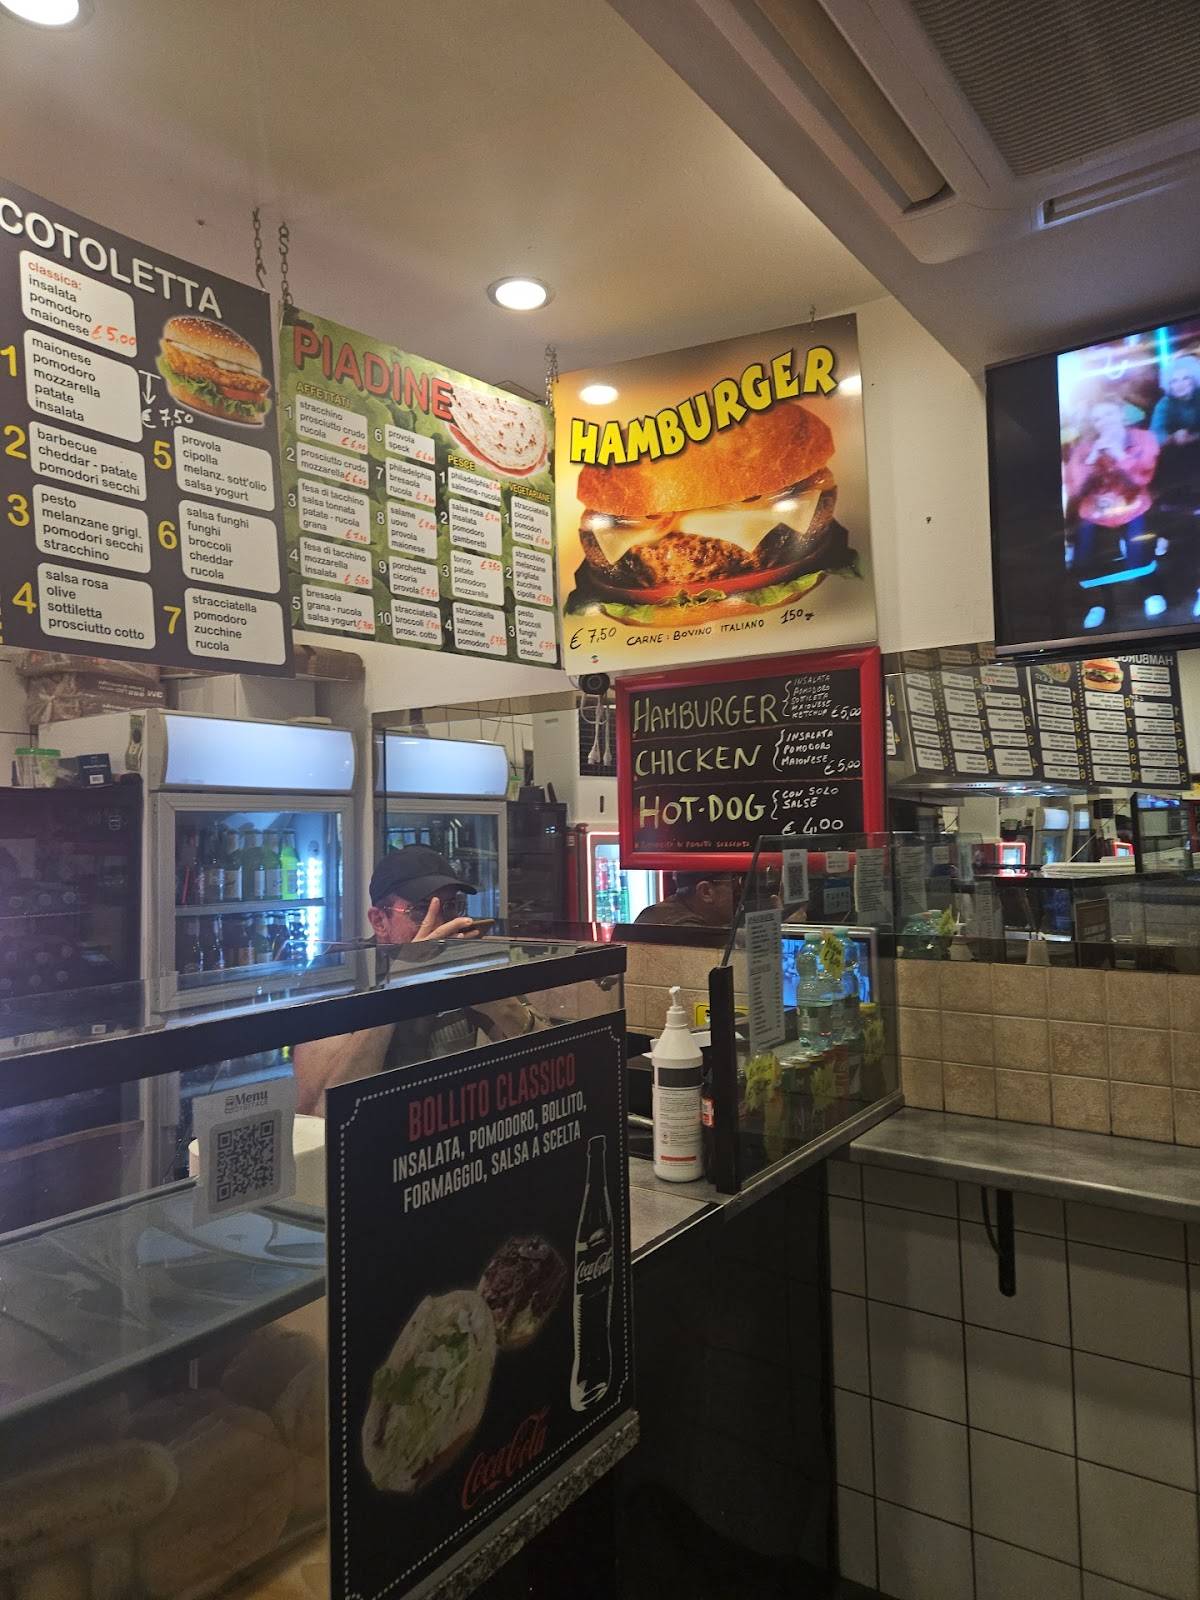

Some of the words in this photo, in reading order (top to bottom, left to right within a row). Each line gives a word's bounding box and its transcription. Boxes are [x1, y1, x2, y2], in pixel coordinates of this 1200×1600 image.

[0, 197, 222, 319] COTOLETTA
[28, 260, 82, 291] classica:
[29, 276, 77, 303] insalata
[30, 291, 92, 323] pomodoro
[30, 306, 90, 337] maionese
[32, 336, 92, 366] maionese
[0, 345, 17, 377] 1
[33, 352, 96, 383] pomodoro
[293, 325, 454, 421] PIADINE
[34, 368, 100, 398] mozzarella
[34, 383, 74, 405] patate
[35, 397, 84, 423] insalata
[285, 405, 293, 420] 1
[300, 401, 343, 421] stracchino
[570, 345, 839, 466] HAMBURGER
[300, 413, 341, 432] prosciutto
[343, 424, 365, 439] crudo
[300, 424, 327, 439] rucola
[374, 428, 383, 442] 6
[4, 424, 27, 460] 2
[37, 427, 97, 455] barbecue
[182, 434, 221, 453] provola
[38, 444, 90, 468] cheddar
[101, 462, 137, 481] patate
[153, 440, 173, 470] 5
[183, 448, 218, 466] cipolla
[286, 447, 296, 462] 2
[301, 448, 342, 467] prosciutto
[344, 458, 367, 473] crudo
[447, 454, 476, 472] PESCE
[39, 459, 99, 486] pomodori
[102, 477, 140, 495] secchi
[184, 463, 225, 481] melanz.
[226, 474, 267, 492] sott'olio
[375, 466, 384, 480] 7
[440, 471, 446, 484] 1
[184, 477, 213, 493] salsa
[215, 485, 249, 501] yogurt
[302, 482, 319, 495] fesa
[321, 486, 330, 497] di
[330, 489, 365, 506] tacchino
[41, 491, 77, 509] pesto
[287, 493, 297, 507] 3
[302, 496, 324, 507] salsa
[325, 500, 355, 515] tonnata
[7, 493, 30, 527] 3
[186, 505, 215, 519] salsa
[216, 512, 249, 530] funghi
[303, 508, 330, 520] patate
[335, 515, 360, 527] rucola
[376, 512, 385, 525] 8
[440, 511, 448, 525] 2
[504, 512, 510, 524] 1
[42, 508, 108, 531] melanzane
[112, 521, 142, 540] grigl.
[187, 519, 221, 538] funghi
[303, 519, 327, 530] grana
[43, 522, 102, 545] pomodori
[106, 536, 143, 553] secchi
[158, 521, 177, 549] 6
[188, 535, 232, 553] broccoli
[43, 538, 110, 561] stracchino
[289, 548, 300, 562] 4
[304, 541, 322, 553] fesa
[323, 545, 331, 555] di
[332, 547, 367, 562] tacchino
[189, 551, 234, 568] cheddar
[304, 556, 348, 569] mozzarella
[378, 560, 387, 574] 9
[190, 565, 224, 580] rucola
[305, 566, 337, 578] insalata
[442, 563, 450, 577] 3
[505, 566, 512, 579] 2
[45, 569, 79, 585] salsa
[82, 577, 109, 591] rosa
[12, 582, 37, 614] 4
[46, 585, 76, 600] olive
[306, 589, 342, 602] bresaola
[47, 602, 103, 619] sottiletta
[192, 594, 257, 613] stracciatella
[292, 596, 301, 610] 5
[306, 602, 331, 613] grana
[337, 605, 362, 617] rucola
[163, 605, 182, 635] 7
[193, 611, 247, 626] pomodoro
[307, 613, 329, 623] salsa
[330, 617, 357, 628] yogurt
[377, 611, 392, 626] 10
[445, 619, 453, 632] 4
[48, 617, 112, 635] prosciutto
[114, 626, 145, 640] cotto
[194, 624, 242, 639] zucchine
[508, 625, 516, 637] 3
[569, 627, 583, 650] €
[673, 626, 712, 642] BOVINO
[720, 619, 765, 633] ITALIANO
[195, 639, 229, 652] rucola
[633, 693, 778, 733] HAMBURGER
[786, 729, 834, 742] INSALATA
[783, 742, 831, 755] POMODORO
[635, 744, 762, 777] CHICKEN
[781, 754, 828, 766] MAIONESE
[782, 789, 803, 800] CON
[808, 786, 839, 796] SOLO
[782, 797, 818, 810] SALSE
[236, 1090, 268, 1105] Menu
[408, 1079, 490, 1142] BOLLITO
[496, 1052, 576, 1111] CLASSICO
[392, 1137, 465, 1183] INSALATA,
[469, 1108, 539, 1154] POMODORO,
[541, 1090, 587, 1124] BOLLITO,
[403, 1159, 488, 1213] FORMAGGIO,
[491, 1137, 529, 1176] SALSA
[531, 1137, 541, 1158] A
[542, 1119, 581, 1153] SCELTA
